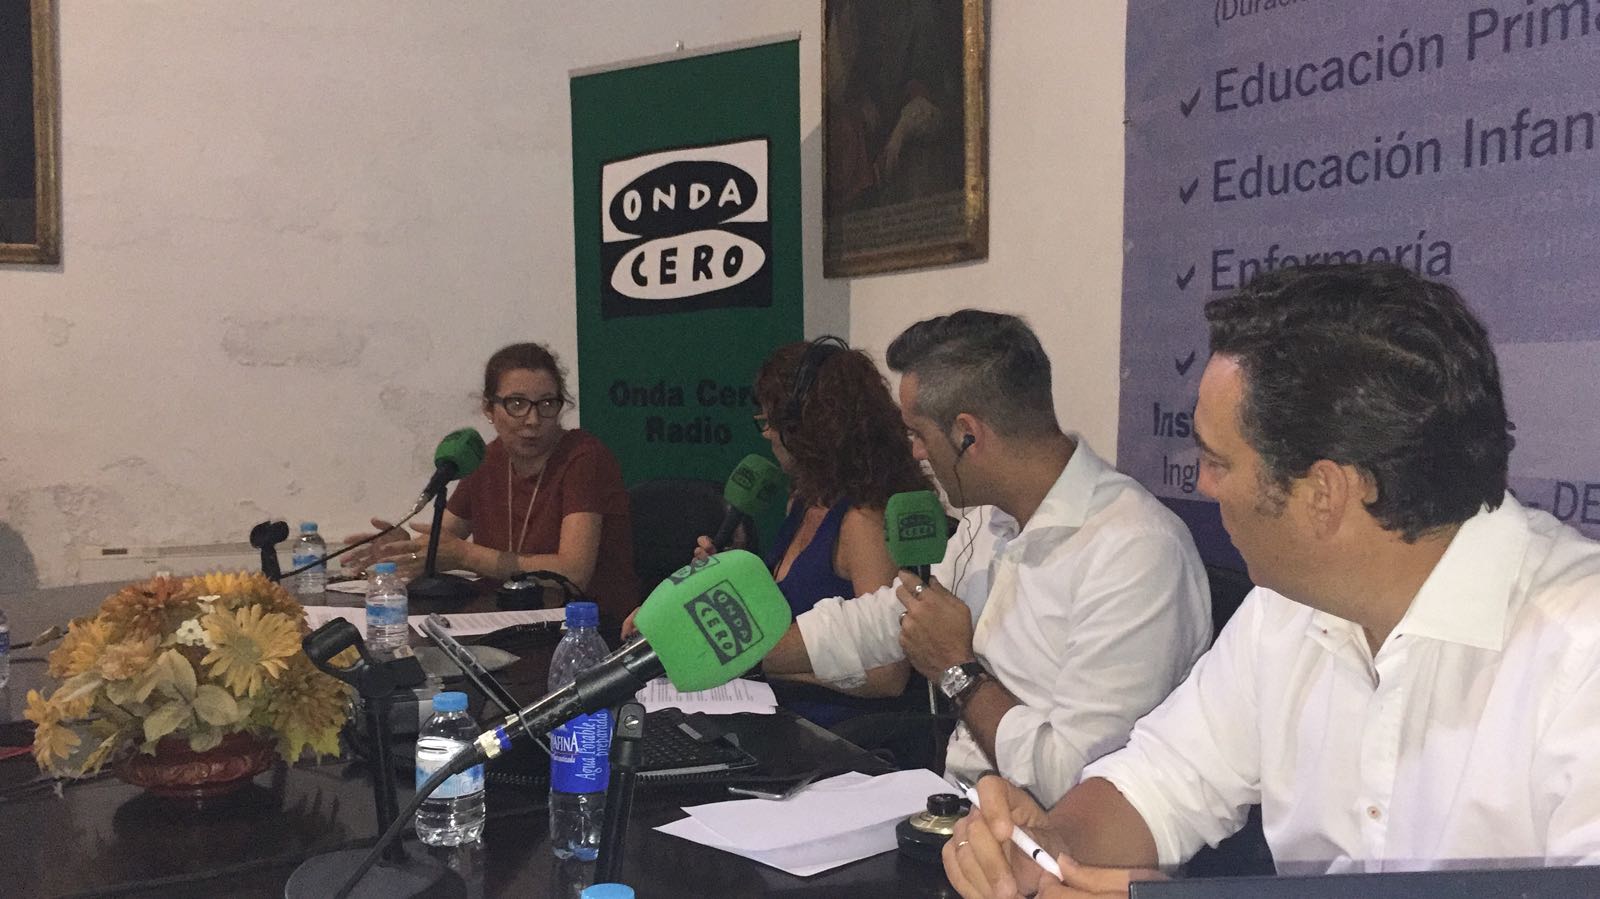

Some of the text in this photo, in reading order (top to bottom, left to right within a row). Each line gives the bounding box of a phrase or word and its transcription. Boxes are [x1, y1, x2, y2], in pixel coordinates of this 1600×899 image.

[1214, 0, 1600, 113] Educación Prim
[1213, 107, 1600, 203] Educación Infan
[623, 178, 742, 222] ONDA
[630, 244, 744, 287] CERO
[608, 378, 757, 408] Onda Cer
[645, 416, 733, 445] Radio
[1153, 402, 1193, 438] Ins
[701, 607, 734, 650] CERO
[717, 593, 748, 640] ONDA
[573, 720, 603, 781] Agua Potable
